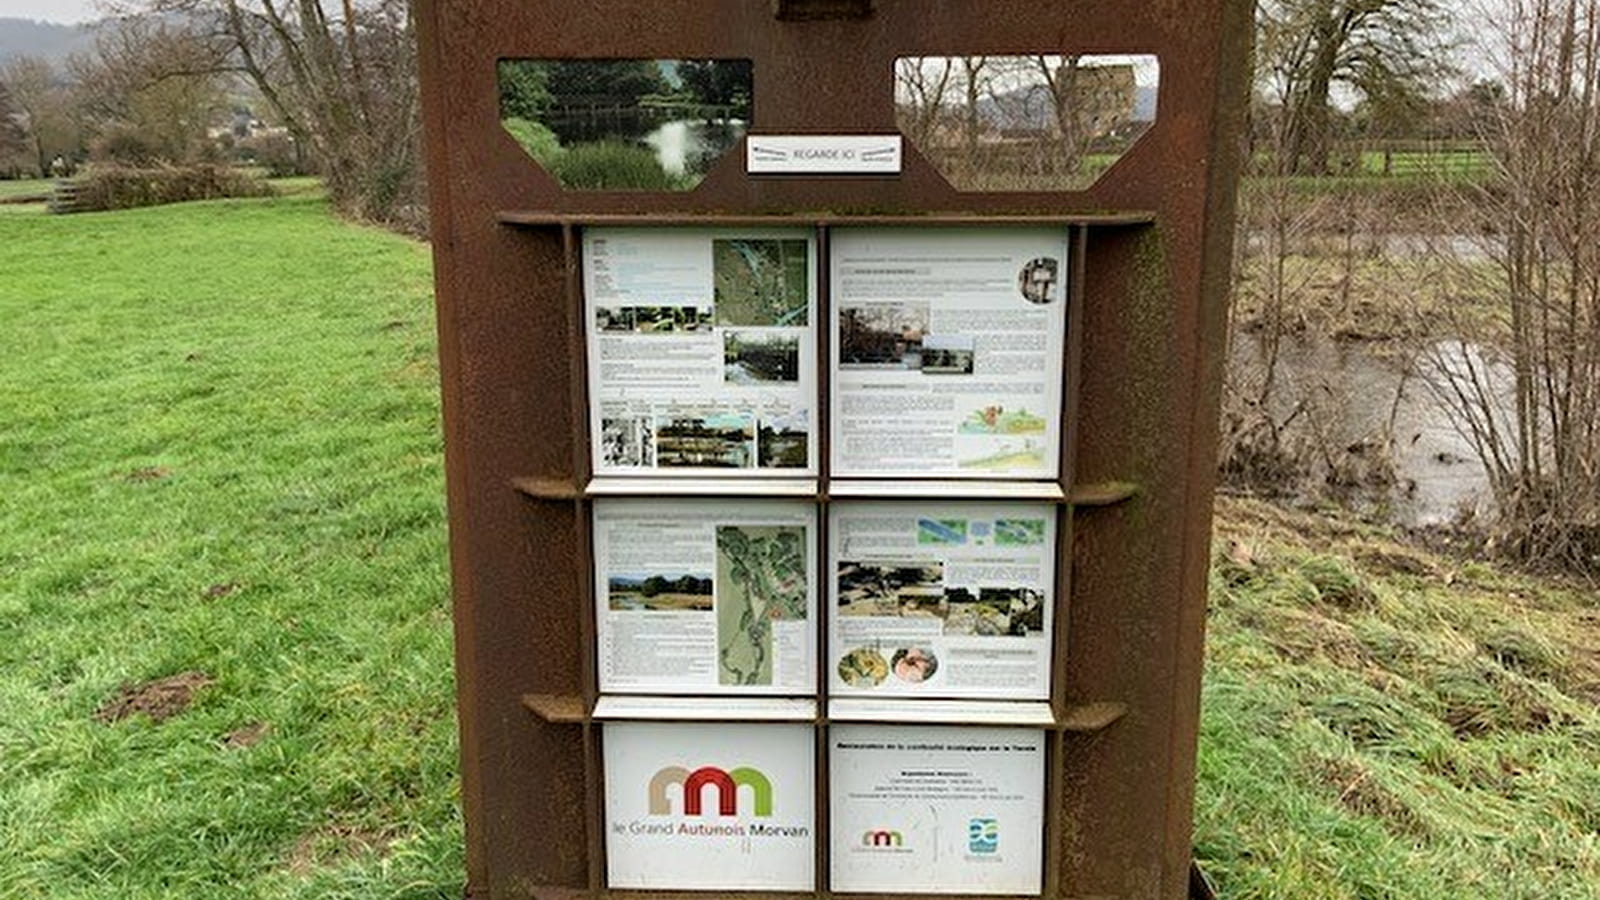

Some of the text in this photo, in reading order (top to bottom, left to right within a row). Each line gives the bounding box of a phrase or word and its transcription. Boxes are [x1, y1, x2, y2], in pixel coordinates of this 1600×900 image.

[793, 148, 856, 159] REGARDE ICI
[613, 822, 809, 837] le Grand Autunois Morvan
